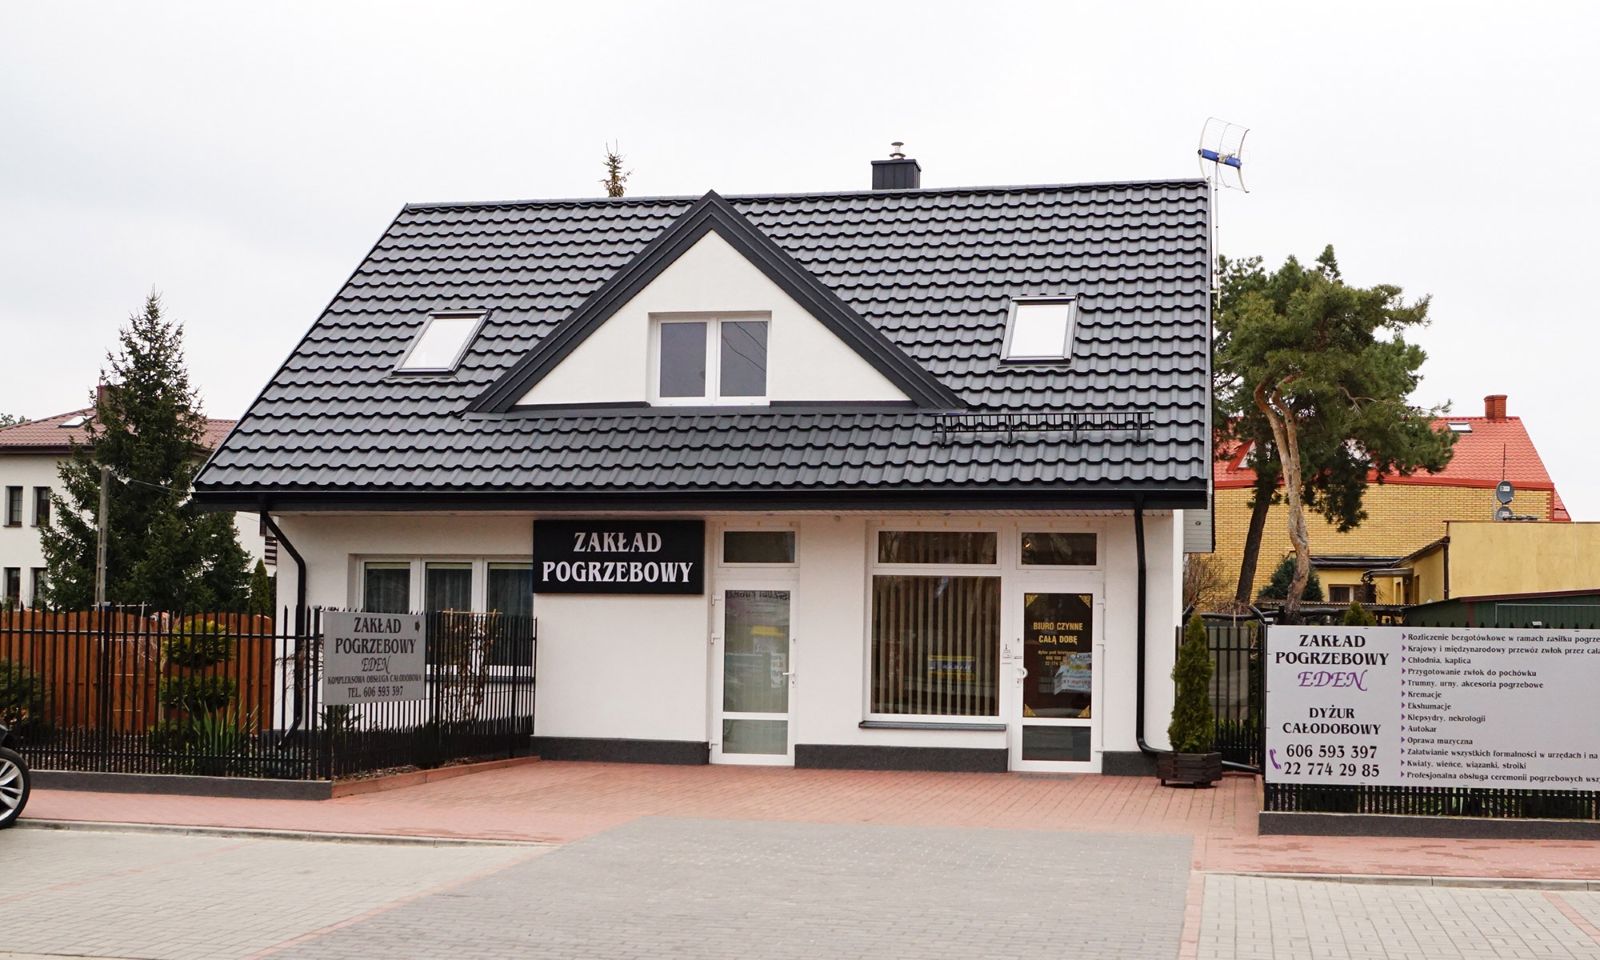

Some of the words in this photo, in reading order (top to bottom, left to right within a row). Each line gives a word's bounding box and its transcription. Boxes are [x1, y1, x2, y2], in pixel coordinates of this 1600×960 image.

[573, 532, 662, 552] ZAKŁAD
[542, 561, 694, 583] POGRZEBOWY
[354, 617, 402, 633] ZAKŁAD
[1033, 622, 1054, 630] BIURO
[1057, 622, 1084, 631] CZYNNE
[1038, 635, 1056, 645] CAŁĄ
[1059, 635, 1078, 645] DOBĘ
[1299, 634, 1366, 648] ZAKŁAD
[1452, 634, 1506, 642] bezgotówkowe
[335, 638, 416, 654] POGRZEBOWY
[1445, 646, 1505, 654] międzynarodowy
[361, 656, 392, 674] EDEN
[1275, 652, 1389, 666] POGRZEBOWY
[1445, 657, 1471, 665] kaplica
[328, 676, 365, 685] KOMPLEKSOWA
[366, 675, 390, 684] OBSŁUGA
[1298, 669, 1368, 691] EDEN
[348, 687, 361, 698] TEL.
[363, 686, 376, 697] 606
[377, 686, 390, 697] 593
[392, 686, 404, 696] 397
[1408, 691, 1442, 699] Kremacje
[1309, 705, 1355, 719] DYŻUR
[1408, 703, 1452, 711] Ekshumacje
[1282, 722, 1381, 735] CAŁODOBOWY
[1286, 744, 1313, 758] 606
[1318, 745, 1344, 758] 593
[1350, 745, 1378, 759] 397
[1284, 762, 1301, 775] 22
[1308, 762, 1333, 776] 774
[1339, 763, 1356, 776] 29
[1362, 764, 1379, 777] 85
[1407, 772, 1456, 780] Profesjonalna
[1459, 773, 1488, 781] obsługa
[1530, 775, 1583, 783] pogrzebowych
